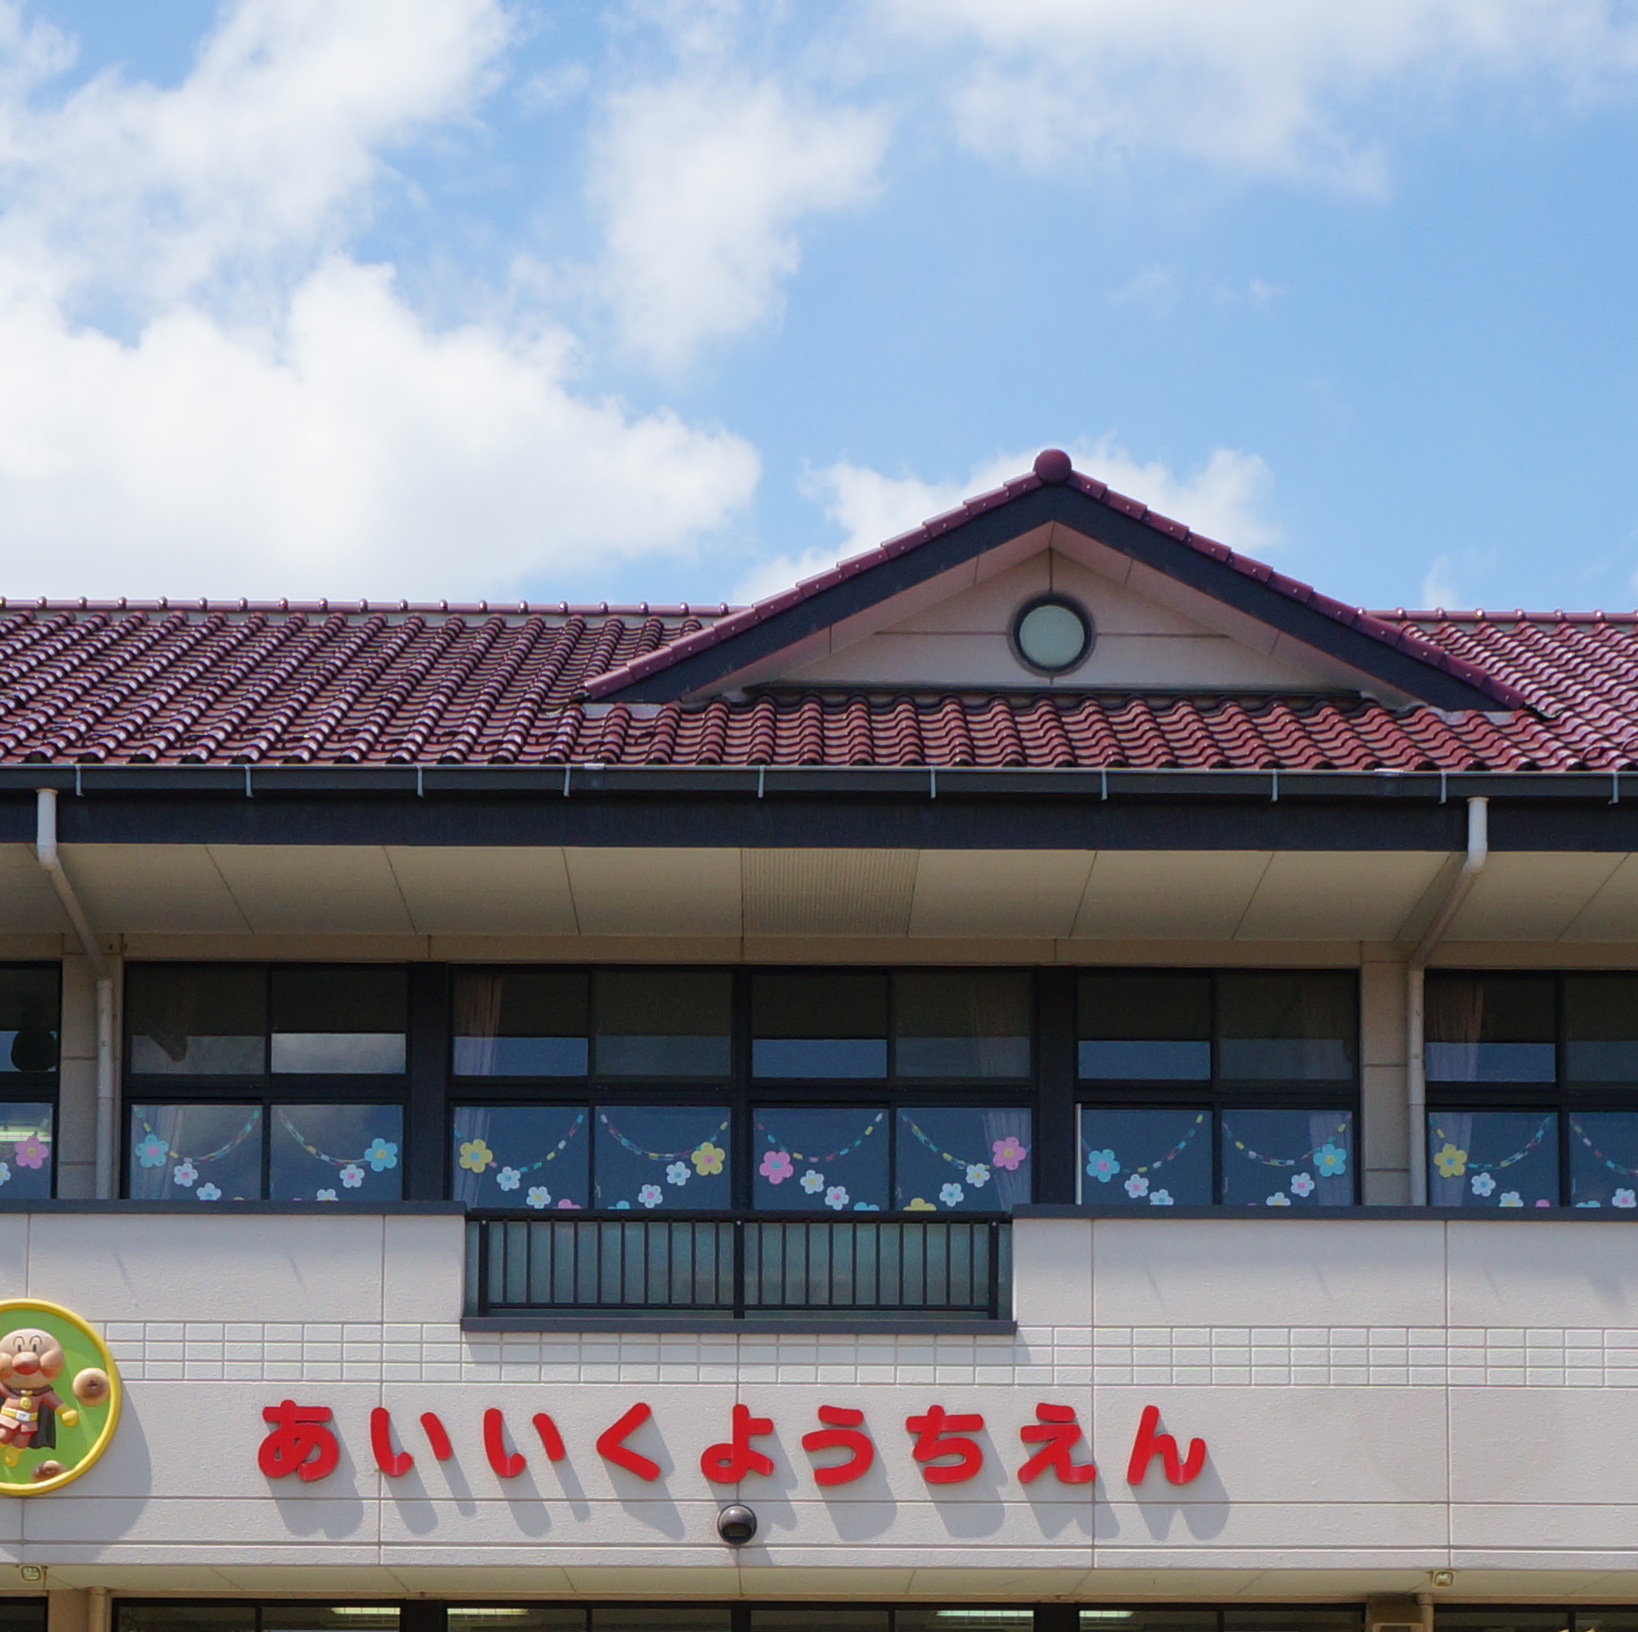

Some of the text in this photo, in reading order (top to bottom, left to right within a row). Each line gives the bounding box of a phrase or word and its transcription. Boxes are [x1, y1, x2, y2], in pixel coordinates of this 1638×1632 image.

[258, 1400, 1206, 1485] あいいくようちえん
